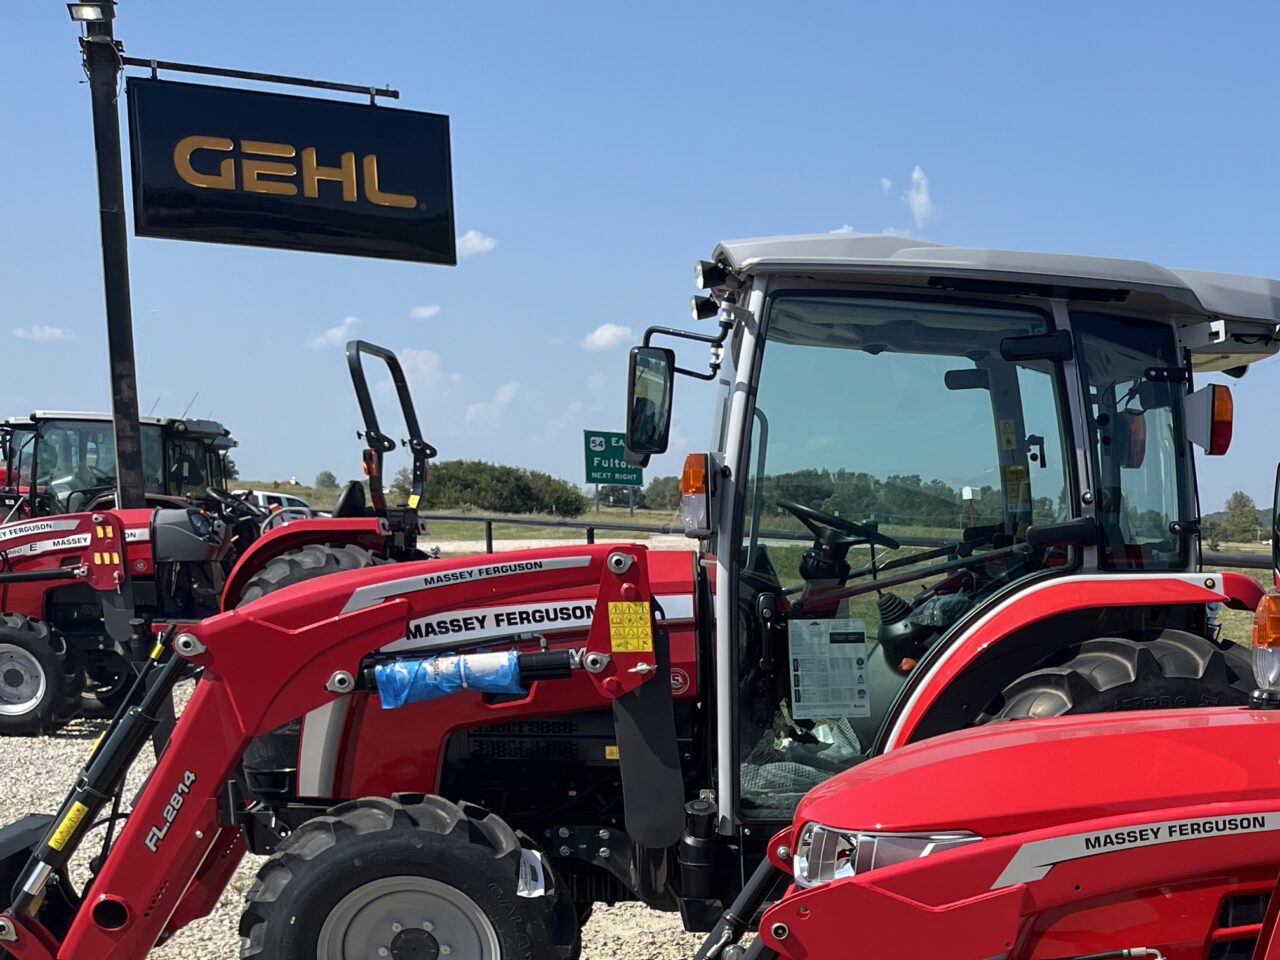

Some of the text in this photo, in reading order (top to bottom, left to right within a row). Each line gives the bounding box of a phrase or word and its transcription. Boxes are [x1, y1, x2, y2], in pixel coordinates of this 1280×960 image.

[173, 134, 418, 210] GEHL
[592, 437, 625, 449] 54 EA
[594, 457, 635, 469] Fulto
[9, 523, 53, 536] FERGUSON
[52, 537, 88, 547] MASSEY
[424, 561, 543, 586] MASSEY FERGUSON
[406, 604, 596, 641] MASSEY FERGUSON
[144, 769, 196, 853] FL.2814
[1084, 815, 1266, 850] MASSEY FERGUSON
